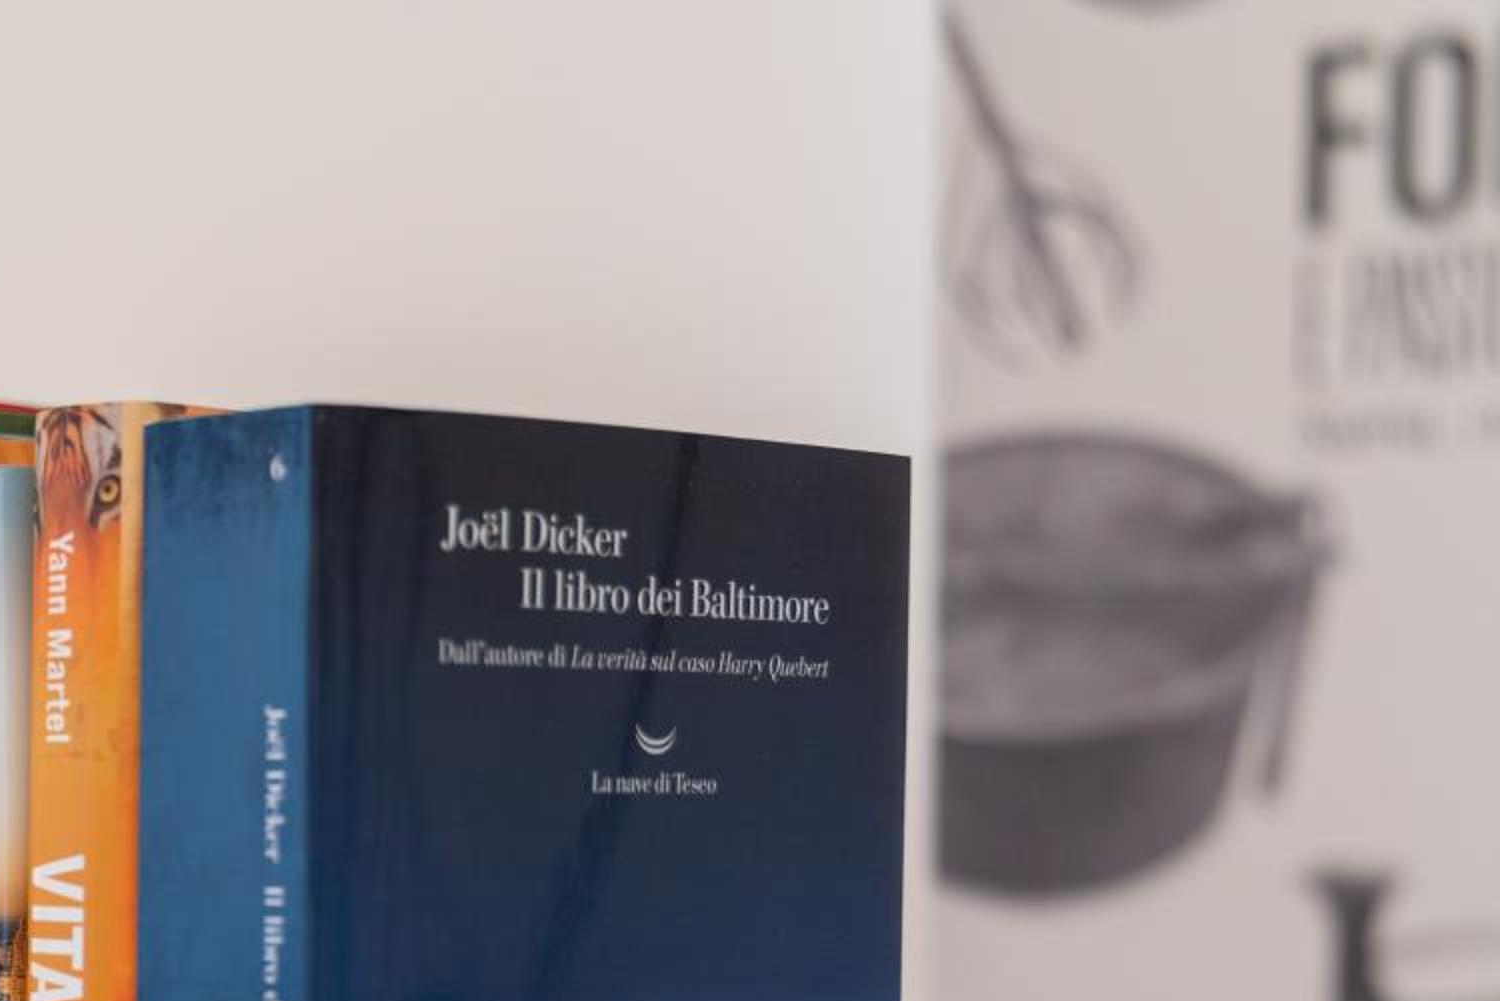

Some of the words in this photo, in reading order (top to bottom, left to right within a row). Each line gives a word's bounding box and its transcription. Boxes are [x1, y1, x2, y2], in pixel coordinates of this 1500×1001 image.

[440, 504, 510, 552] Joël
[521, 510, 628, 558] Dicker
[47, 531, 76, 614] Yann
[519, 566, 545, 610] Il
[554, 569, 630, 614] libro
[637, 575, 682, 617] dei
[690, 579, 830, 625] Baltimore
[45, 629, 72, 743] Martel
[547, 643, 567, 669] di
[570, 644, 594, 671] La
[596, 648, 647, 673] verità
[649, 650, 677, 673] sul
[677, 655, 717, 674] caso
[717, 651, 767, 683] Harry
[768, 654, 830, 684] Quebert
[592, 770, 612, 795] La
[615, 775, 652, 795] nave
[653, 770, 670, 795] di
[671, 771, 718, 796] Teseo
[264, 769, 287, 864] Dicker
[263, 885, 286, 907] Il
[263, 915, 285, 985] libro
